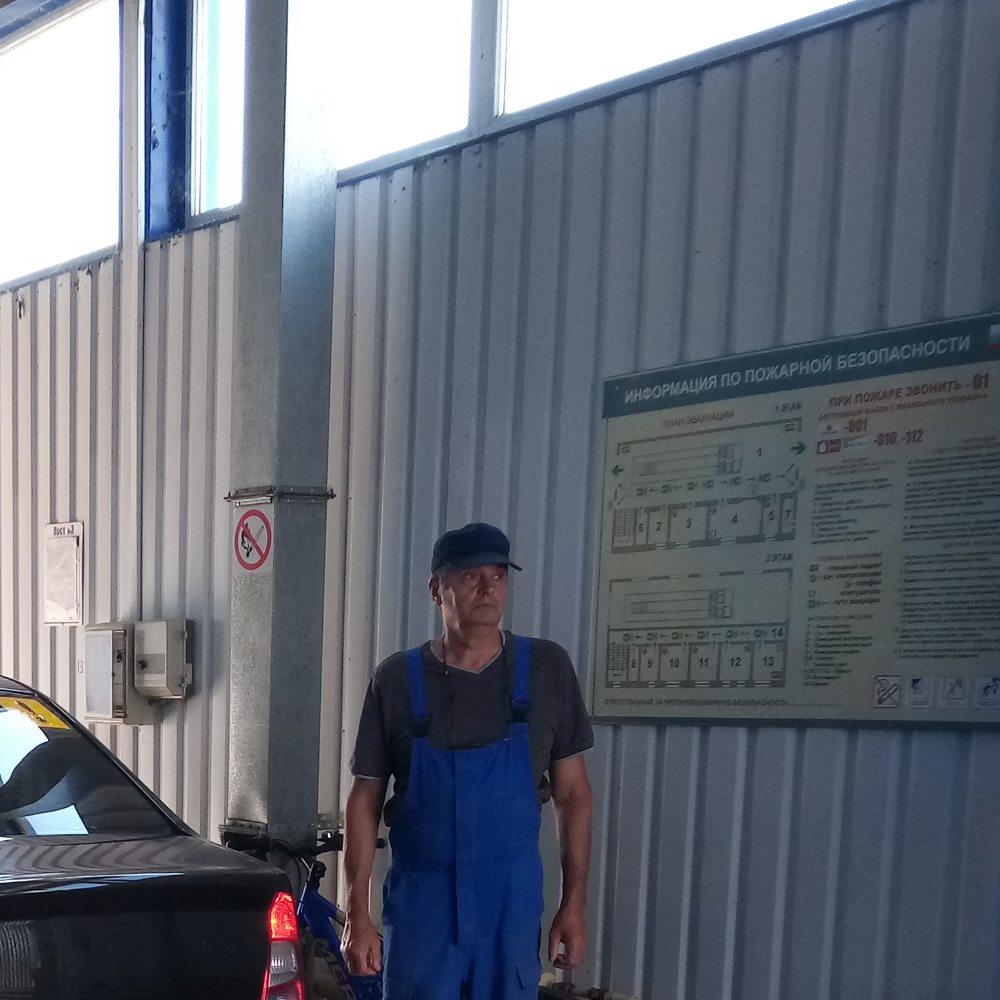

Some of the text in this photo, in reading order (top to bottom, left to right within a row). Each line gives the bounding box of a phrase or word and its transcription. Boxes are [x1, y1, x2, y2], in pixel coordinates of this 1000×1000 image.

[625, 334, 971, 404] ИНФОРМАЦИЯ ПО ПОЖАРНОЙ БЕЗОПАСНОСТИ
[829, 397, 852, 408] ПРИ
[855, 387, 903, 405] ПОЖАРЕ
[906, 380, 962, 397] ЗВОНИТЬ
[729, 656, 742, 668] 12
